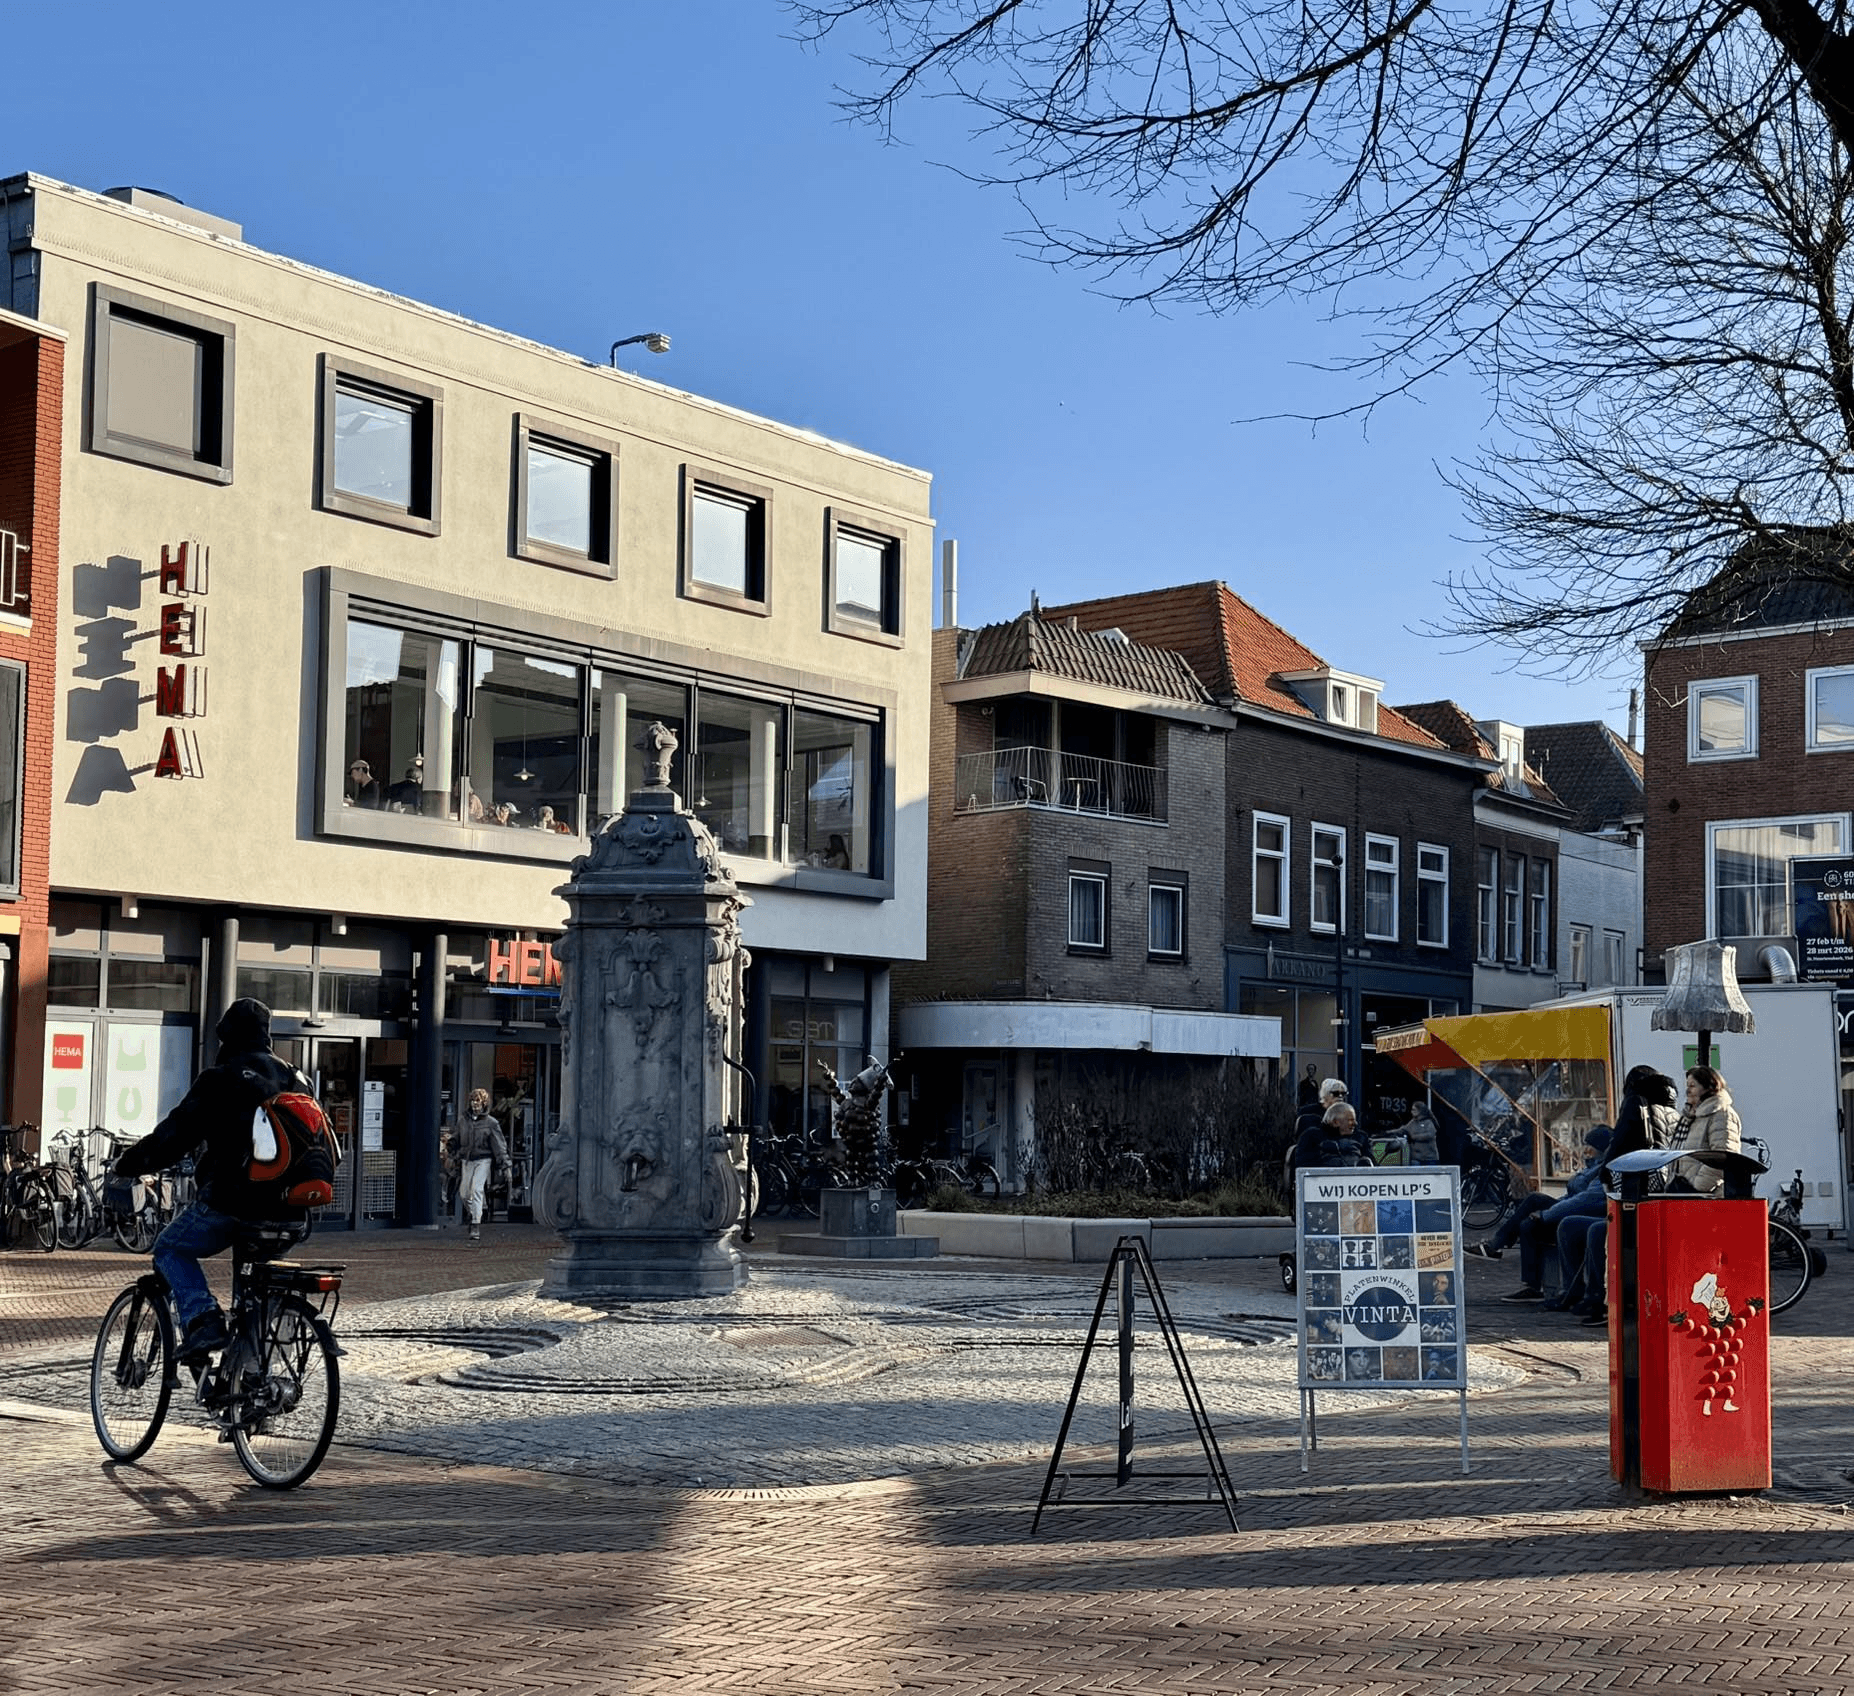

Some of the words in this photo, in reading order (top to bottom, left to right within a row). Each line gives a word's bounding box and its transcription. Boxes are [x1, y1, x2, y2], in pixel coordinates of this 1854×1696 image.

[154, 540, 207, 780] HEMA
[1816, 891, 1837, 901] Een
[1817, 937, 1830, 945] feb
[1833, 946, 1854, 954] 2026
[54, 1046, 82, 1057] HEMA
[1318, 1185, 1344, 1199] WIJ
[1348, 1184, 1398, 1197] KOPEN
[1402, 1183, 1431, 1196] LP'S
[1344, 1275, 1415, 1303] PLATENWINKEL
[1344, 1305, 1417, 1324] VINTA
